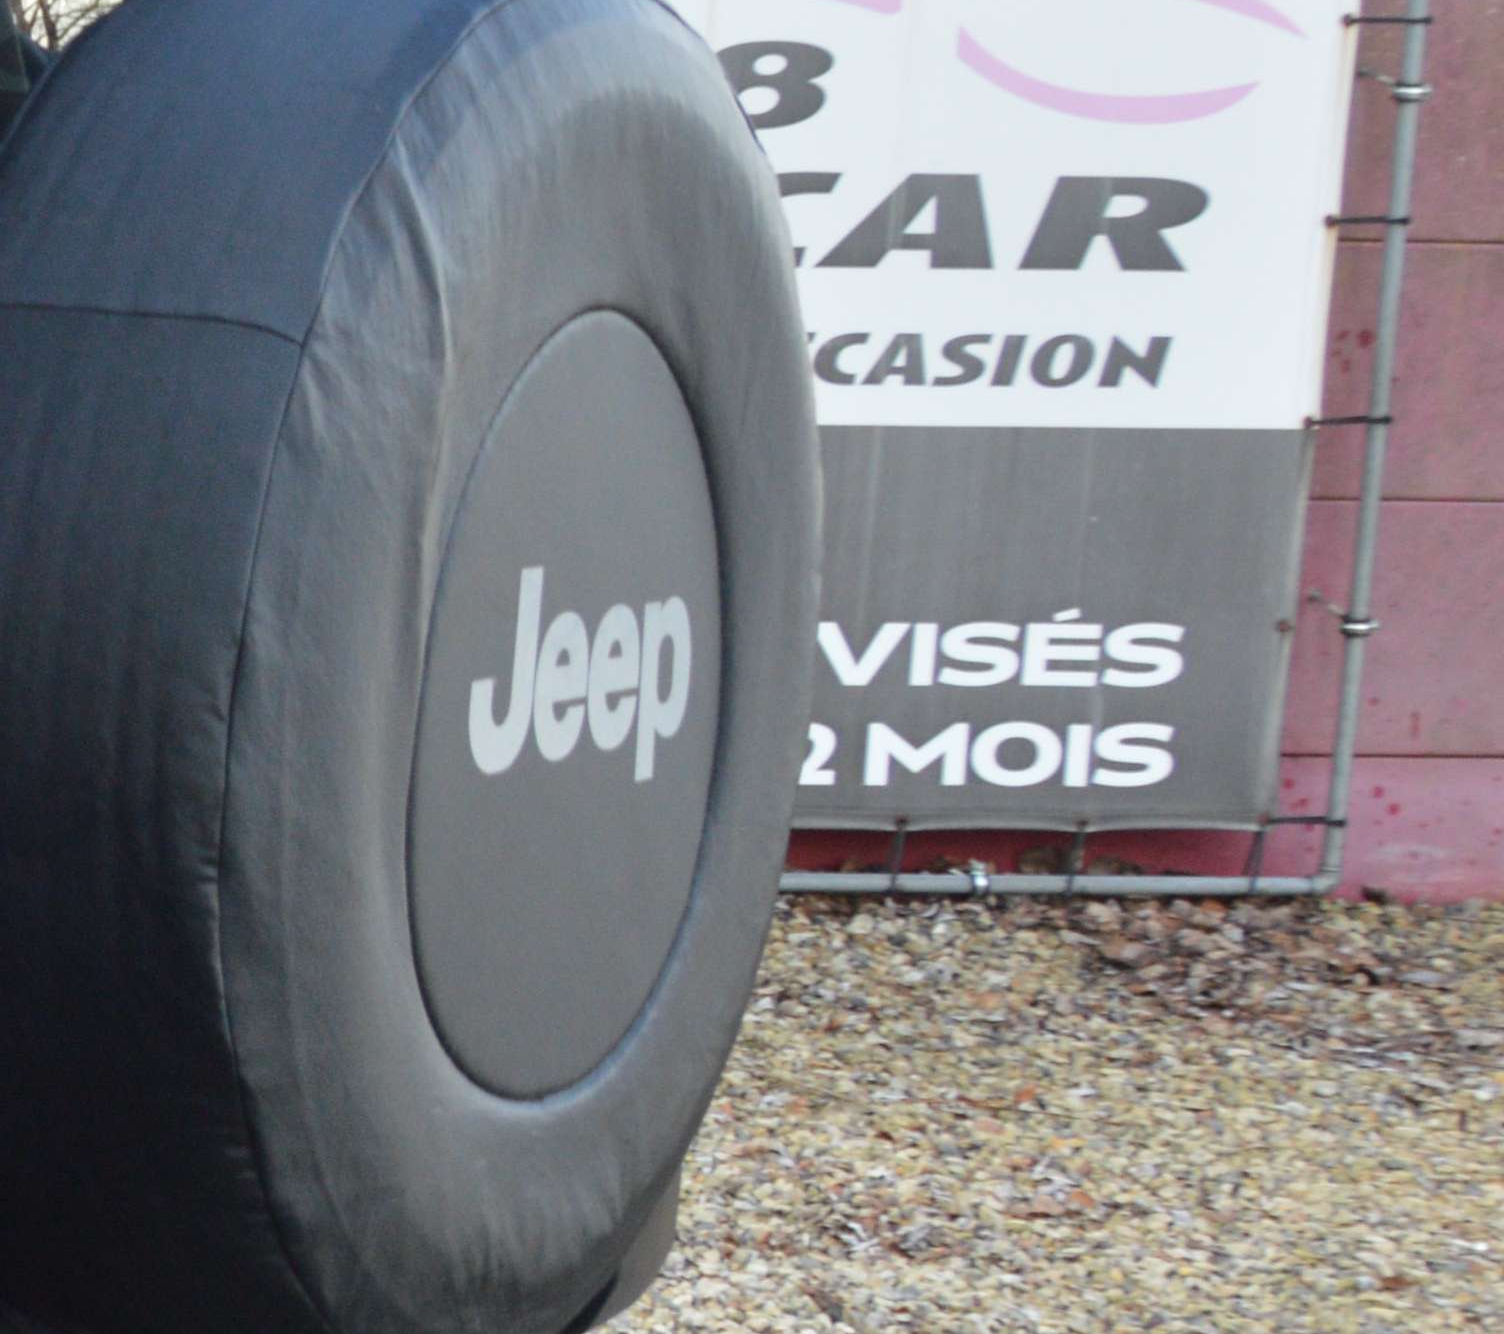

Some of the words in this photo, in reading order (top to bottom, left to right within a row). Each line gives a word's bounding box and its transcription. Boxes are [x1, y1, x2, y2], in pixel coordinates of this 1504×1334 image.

[806, 331, 1173, 388] CASION
[468, 565, 693, 784] Jeep
[863, 722, 1175, 788] MOIS
